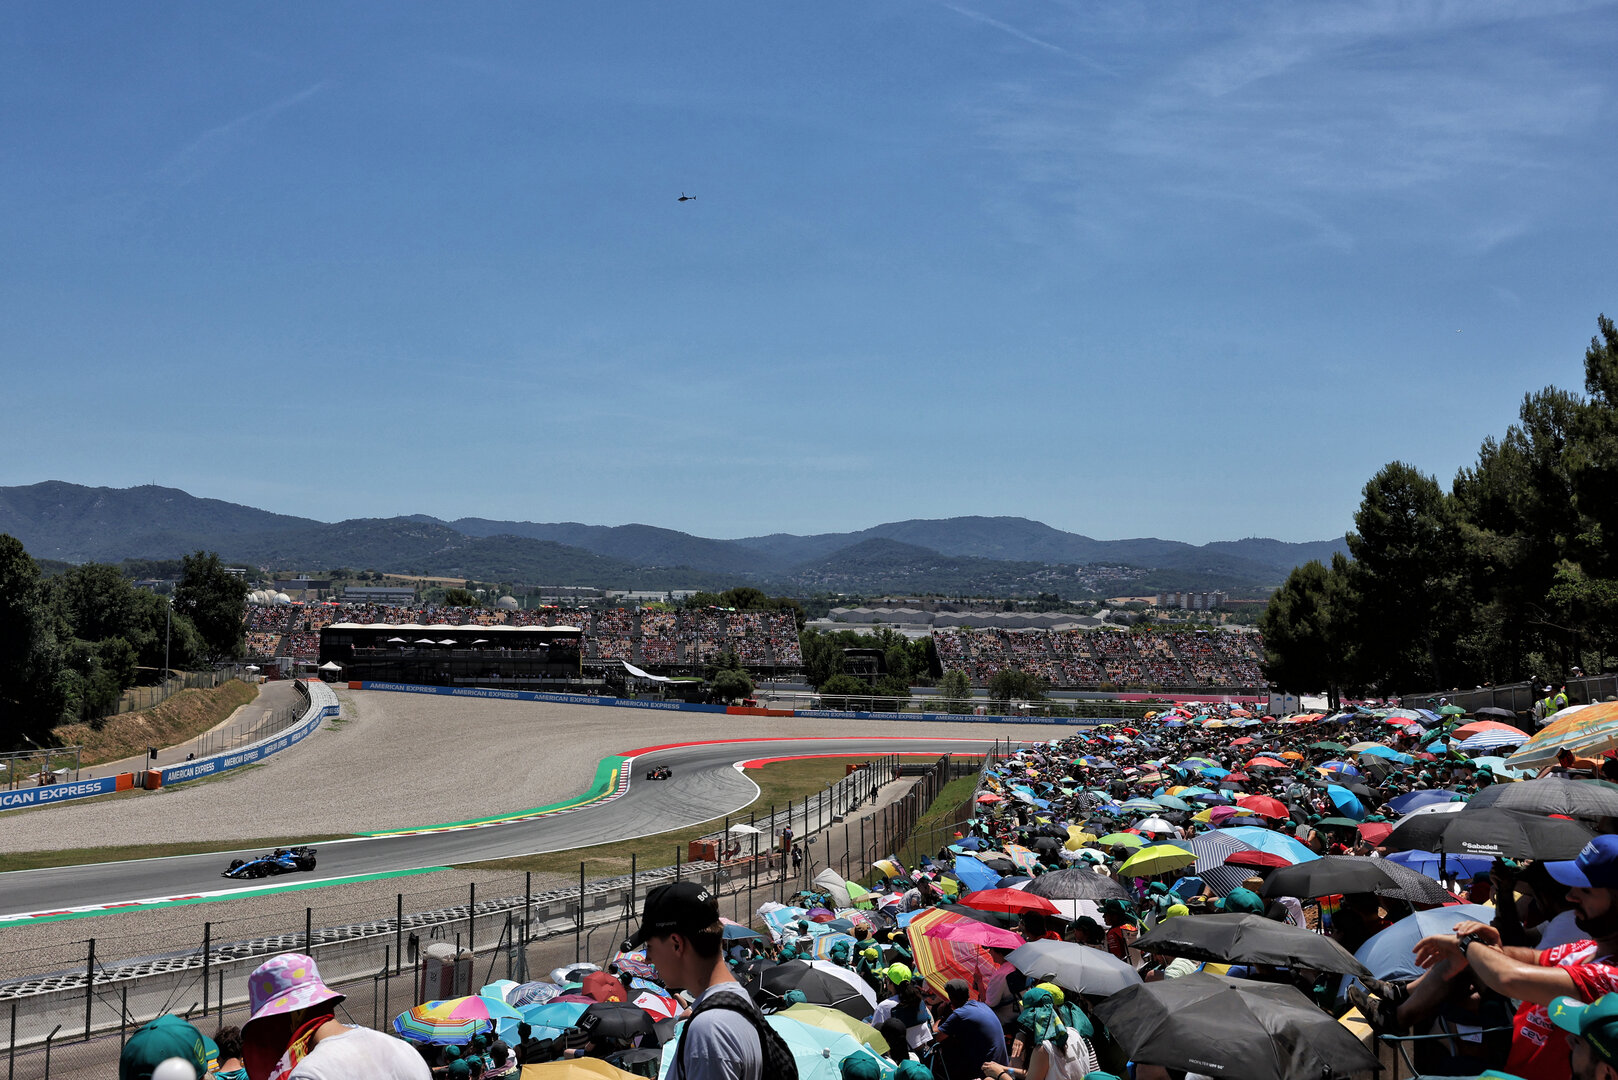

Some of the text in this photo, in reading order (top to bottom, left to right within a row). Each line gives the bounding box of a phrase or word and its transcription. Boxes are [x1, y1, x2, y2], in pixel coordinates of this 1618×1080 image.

[369, 682, 437, 694] AMERICAN EXPRESS
[452, 689, 519, 699] AMERICAN EXPRESS
[533, 694, 600, 704] AMERICAN EXPRESS
[615, 699, 680, 710] AMERICAN EXPRESS
[224, 750, 259, 768] AMERICAN EXPRESS
[167, 762, 215, 781] AMERICAN EXPRESS
[40, 782, 102, 800] EXPRESS
